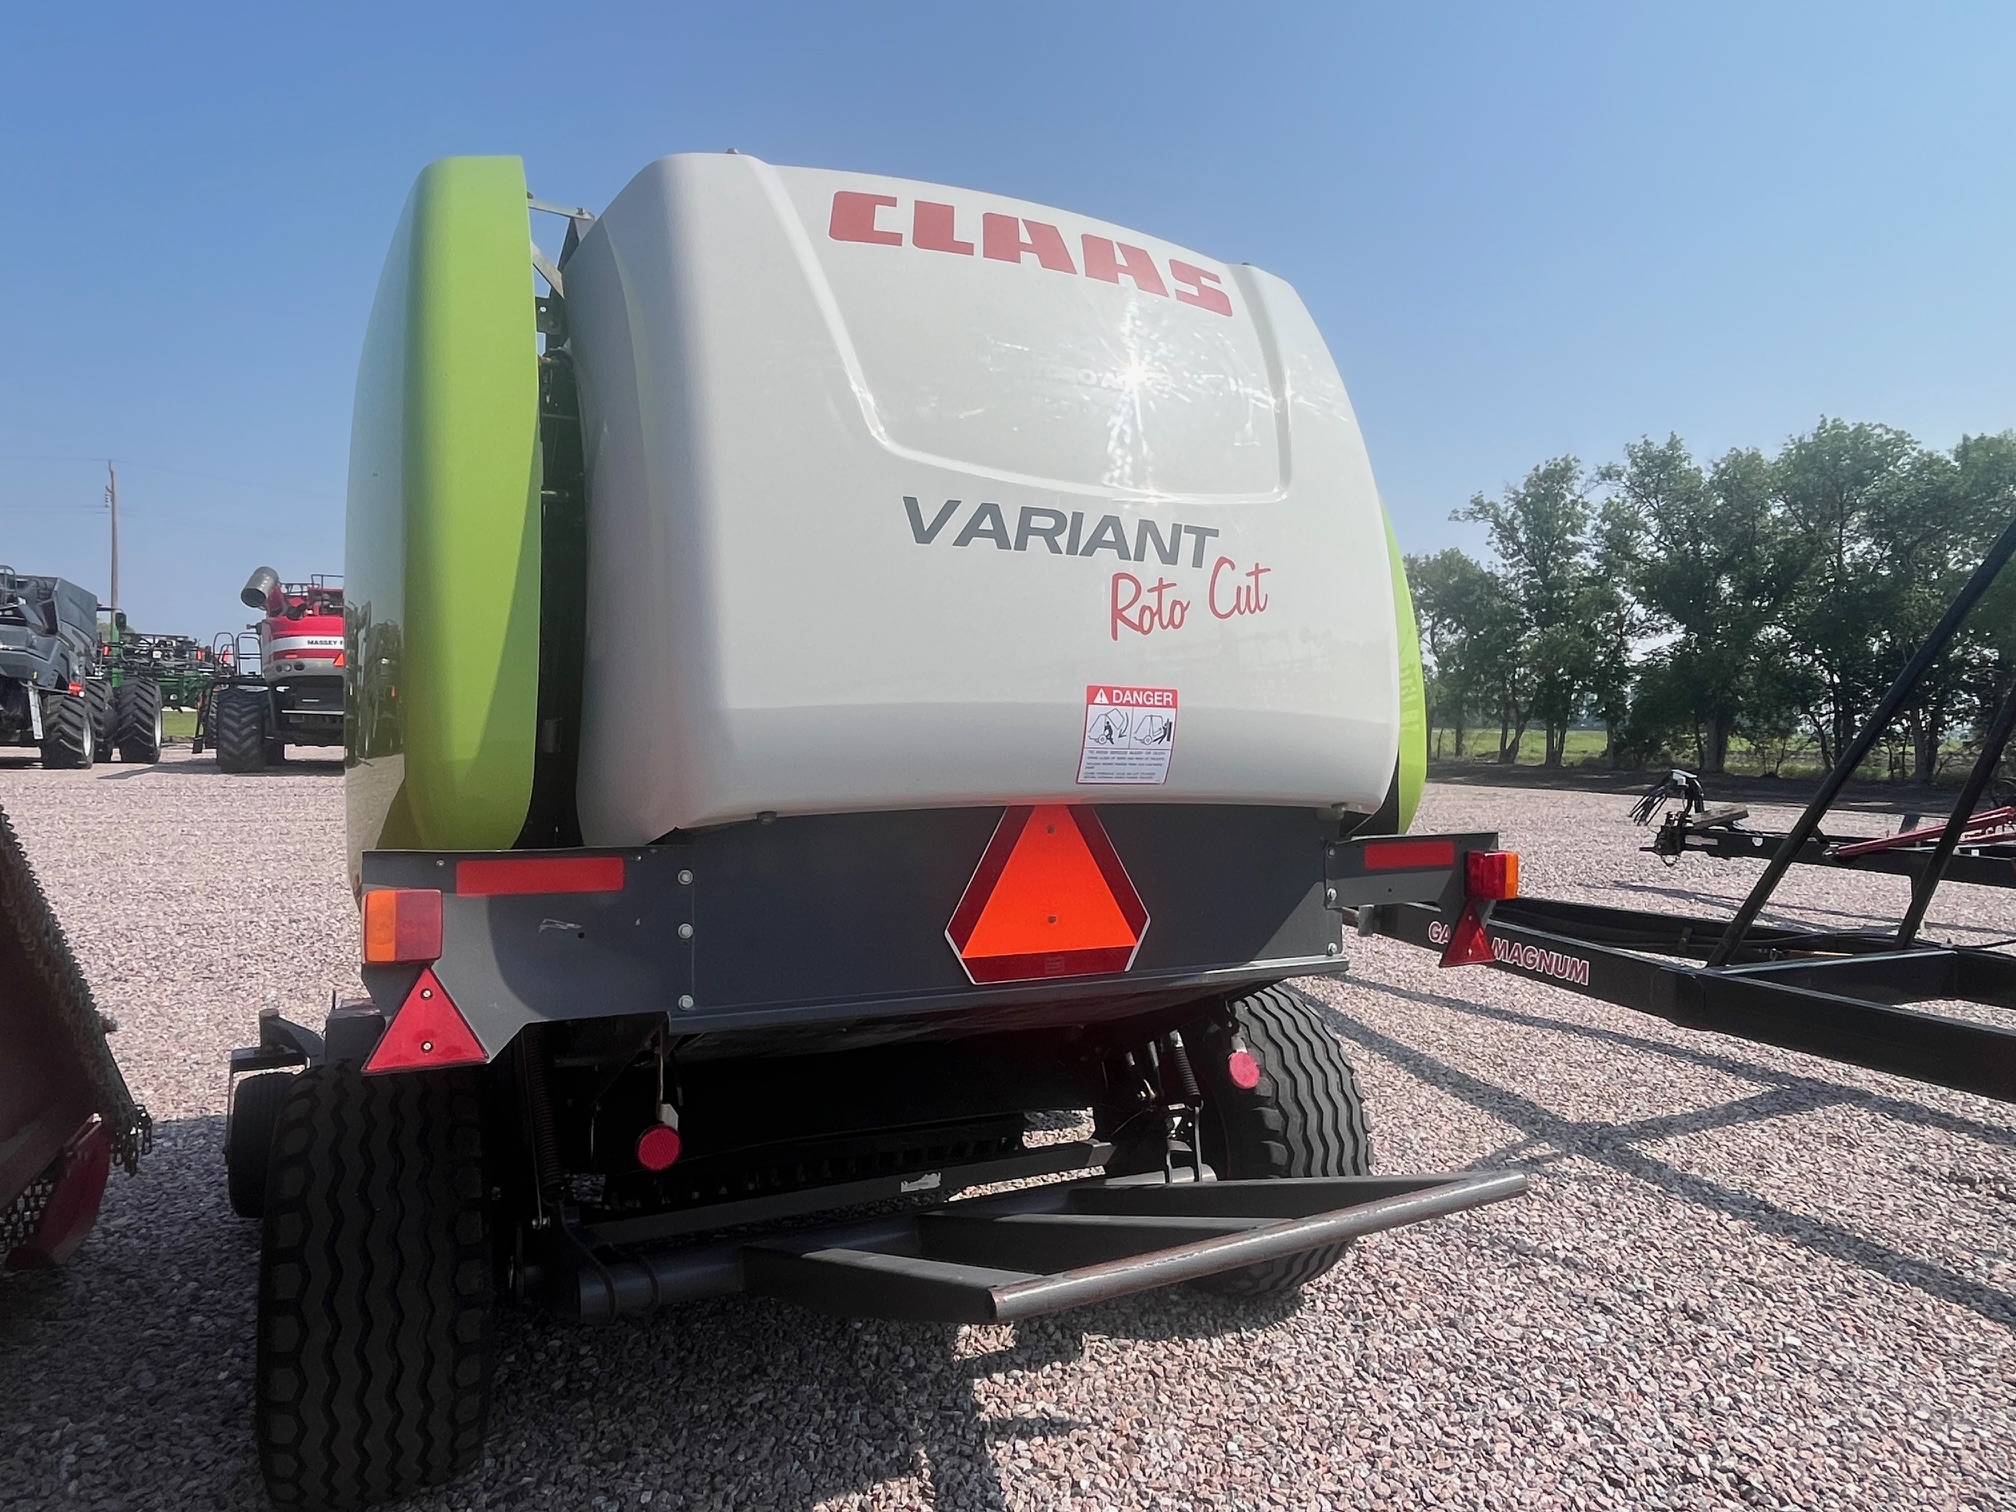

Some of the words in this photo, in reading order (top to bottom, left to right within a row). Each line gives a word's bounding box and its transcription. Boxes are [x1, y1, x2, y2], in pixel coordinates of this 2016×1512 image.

[829, 191, 1233, 318] CLAAS
[903, 496, 1220, 568] VARIANT
[1111, 572, 1190, 641] Roto
[1209, 556, 1271, 620] Cut
[1112, 689, 1173, 706] DANGER
[1491, 937, 1590, 986] MAGNUM
